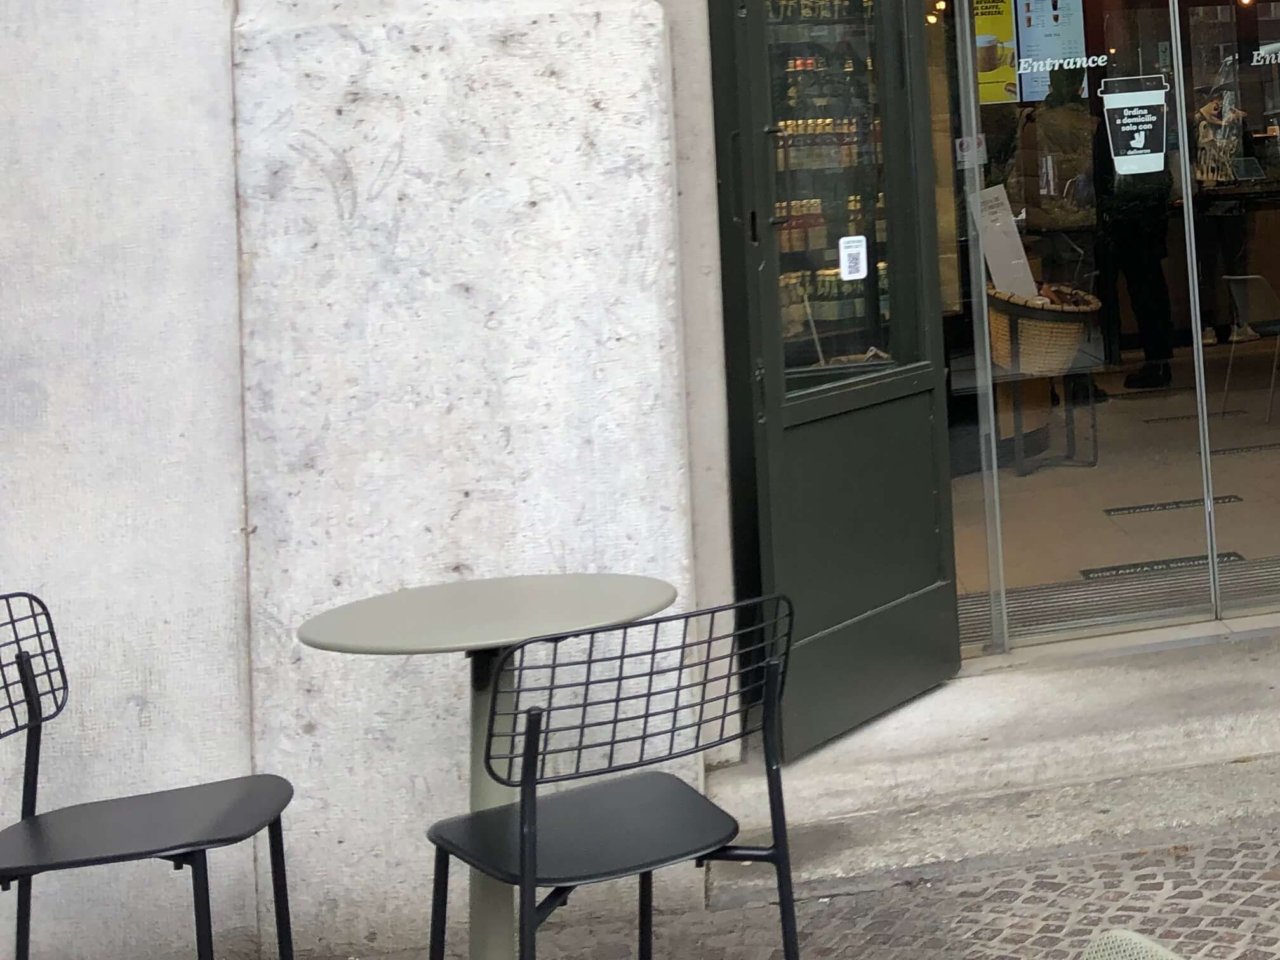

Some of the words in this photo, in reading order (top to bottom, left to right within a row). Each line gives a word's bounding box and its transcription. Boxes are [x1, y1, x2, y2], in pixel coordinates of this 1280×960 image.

[1017, 55, 1108, 73] Entrance
[1123, 107, 1148, 116] Ordina
[1122, 114, 1157, 124] domicilio
[1121, 123, 1137, 132] solo
